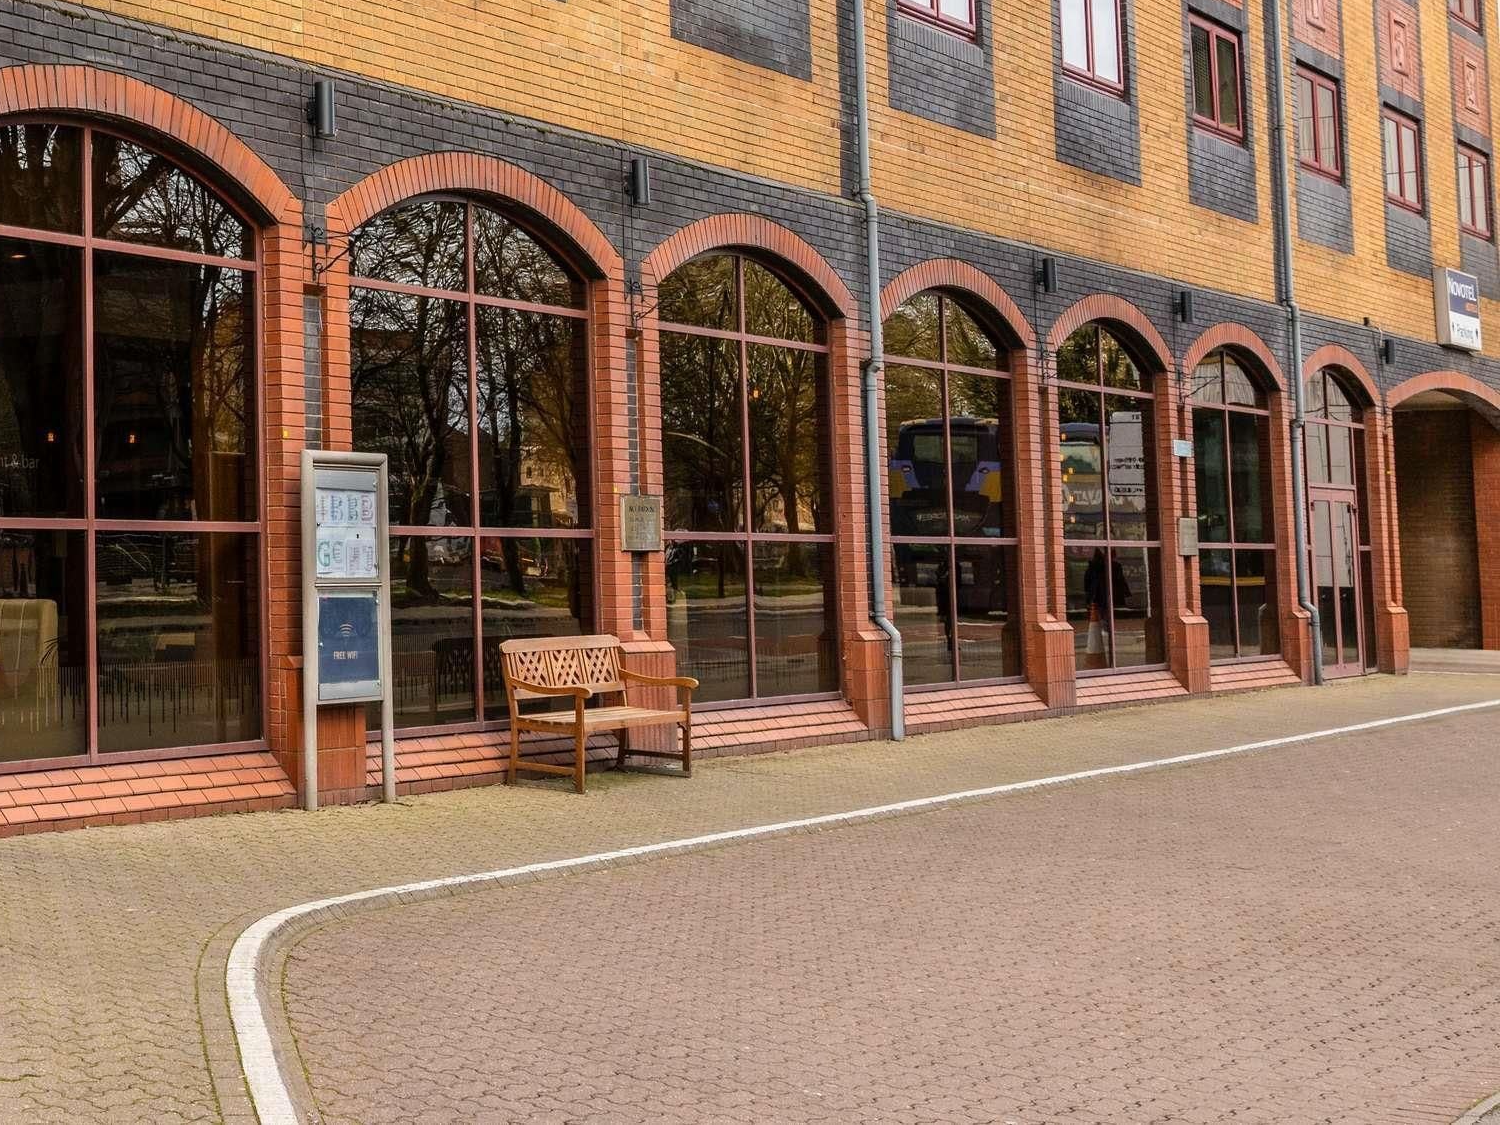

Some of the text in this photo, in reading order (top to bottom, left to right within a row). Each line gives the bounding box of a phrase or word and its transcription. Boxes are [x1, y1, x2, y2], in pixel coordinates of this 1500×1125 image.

[1447, 276, 1477, 302] NOVOTEL
[11, 452, 19, 468] &
[21, 453, 41, 469] bar
[333, 650, 358, 660] FREE WIFI
